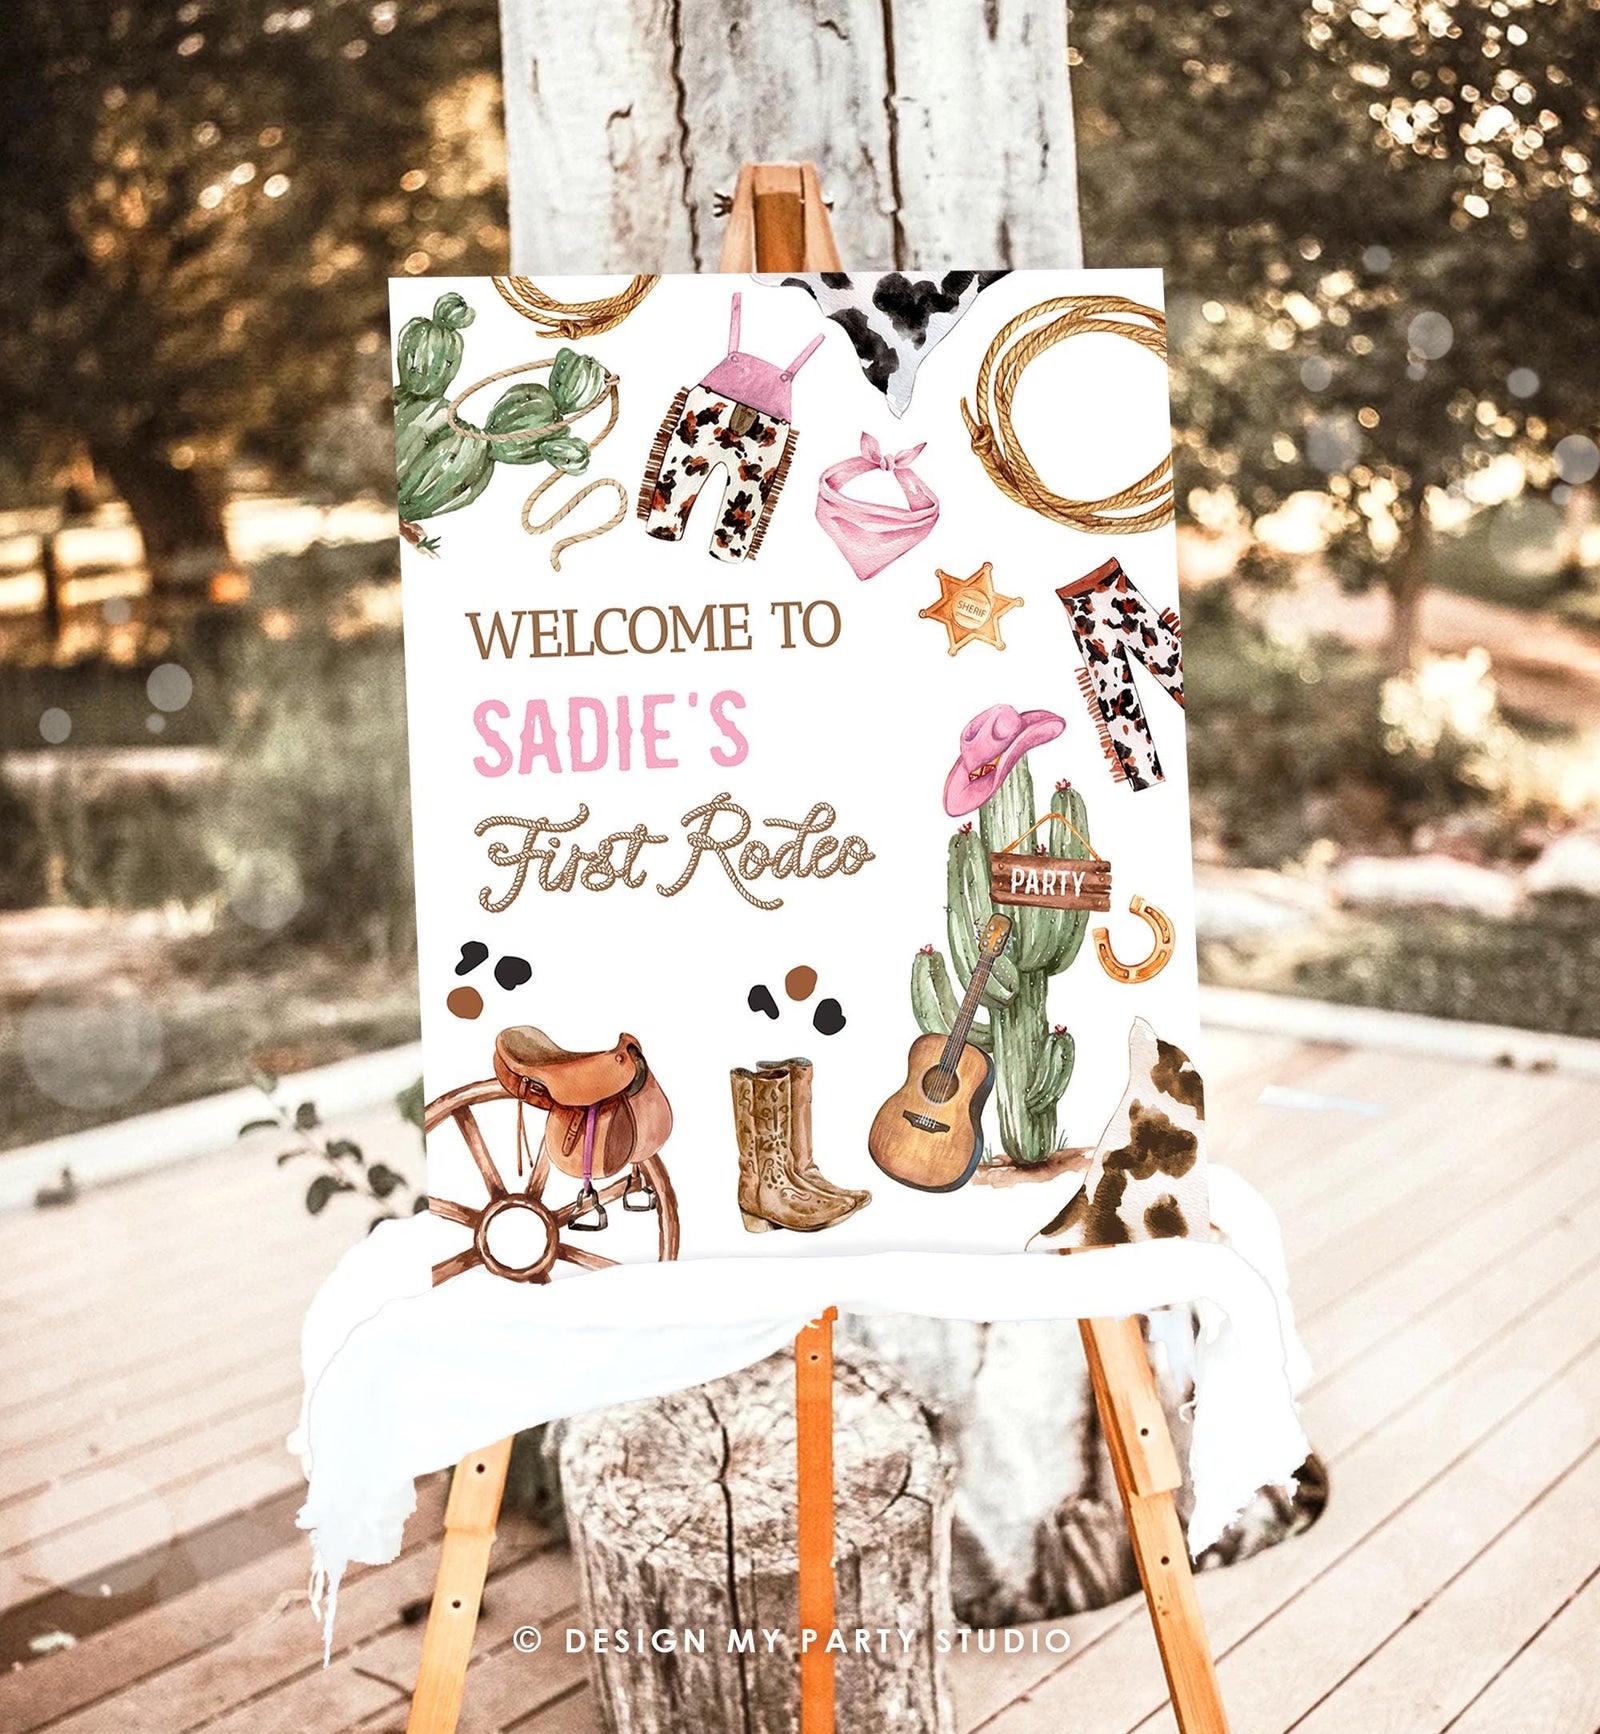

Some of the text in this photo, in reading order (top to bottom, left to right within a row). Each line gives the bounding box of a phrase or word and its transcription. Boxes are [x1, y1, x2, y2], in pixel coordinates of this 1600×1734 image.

[464, 600, 842, 660] WELCOME TO
[957, 600, 987, 617] SHERIF
[473, 690, 749, 778] SADIE'S
[474, 792, 876, 913] First Rodeo
[1010, 868, 1086, 897] PARTY
